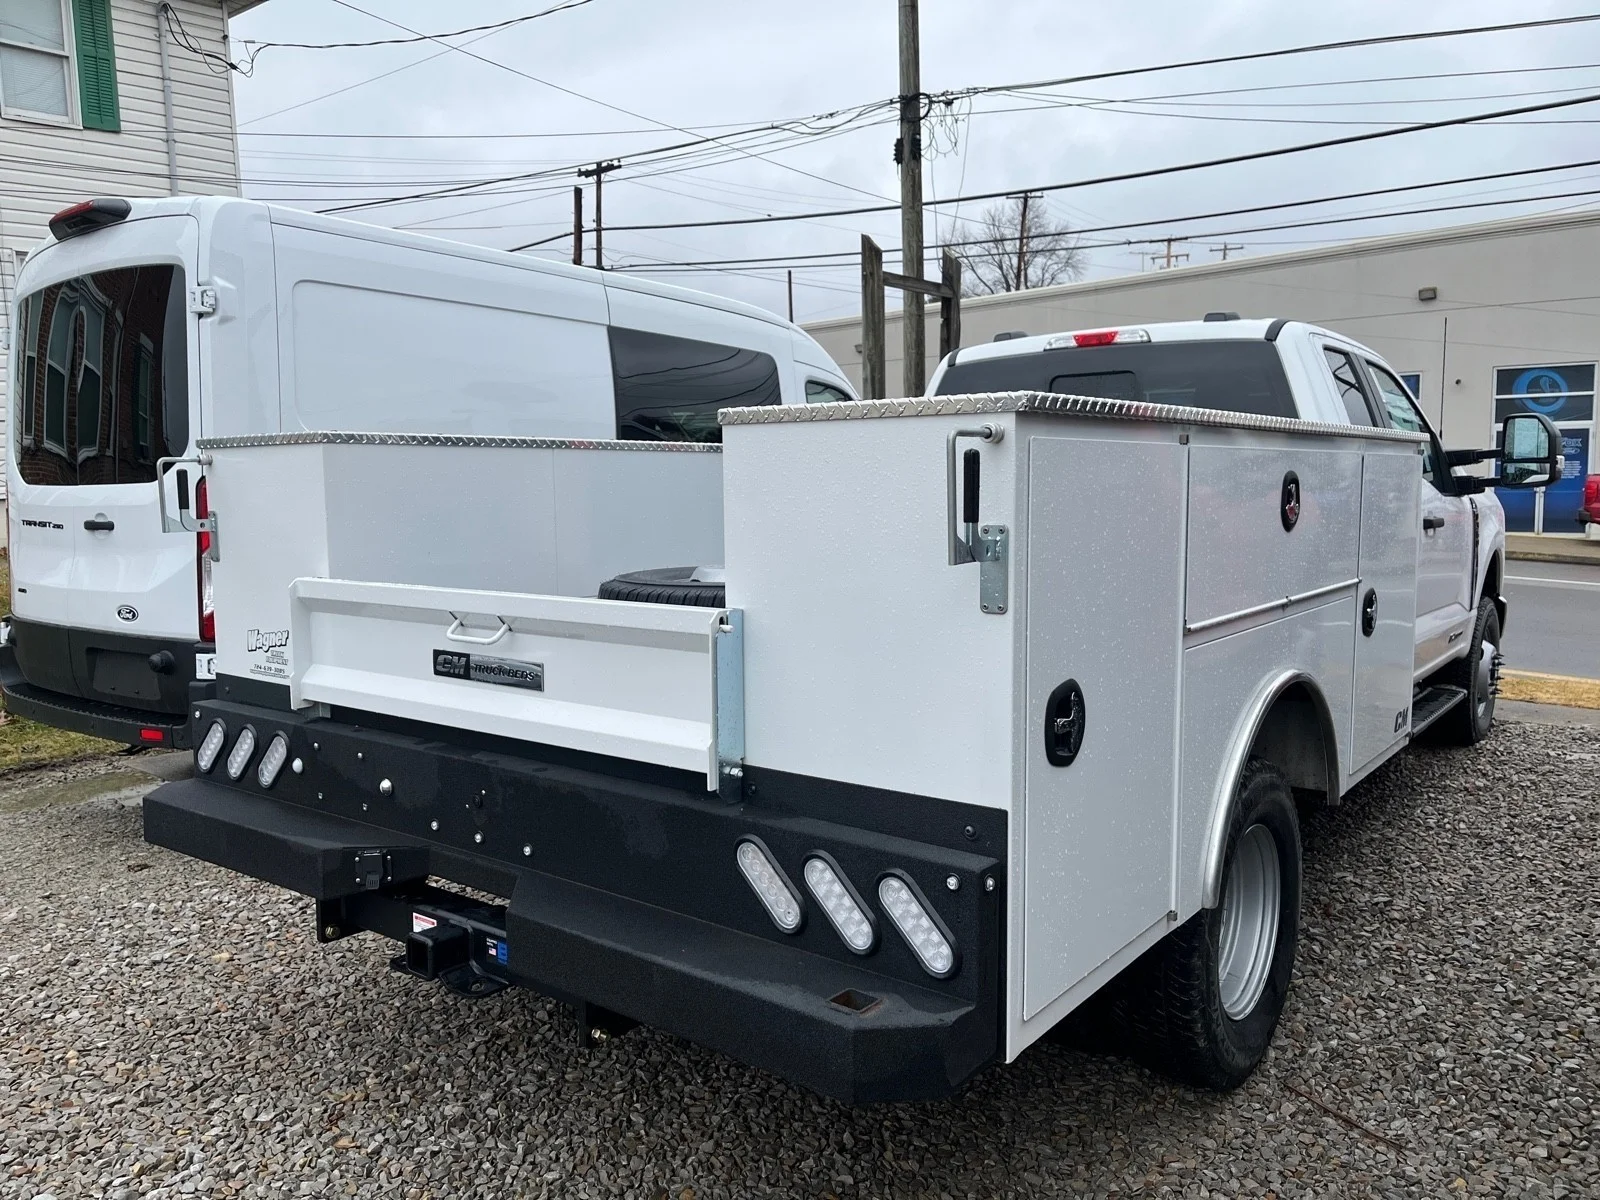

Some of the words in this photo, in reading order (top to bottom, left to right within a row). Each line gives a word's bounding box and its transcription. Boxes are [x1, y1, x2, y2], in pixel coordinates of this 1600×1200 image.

[21, 519, 52, 528] TRANSIT
[247, 629, 289, 652] Wagner
[435, 654, 467, 675] CM
[474, 664, 506, 676] TRUCK
[507, 669, 535, 681] BEDS
[1394, 707, 1409, 733] CM
